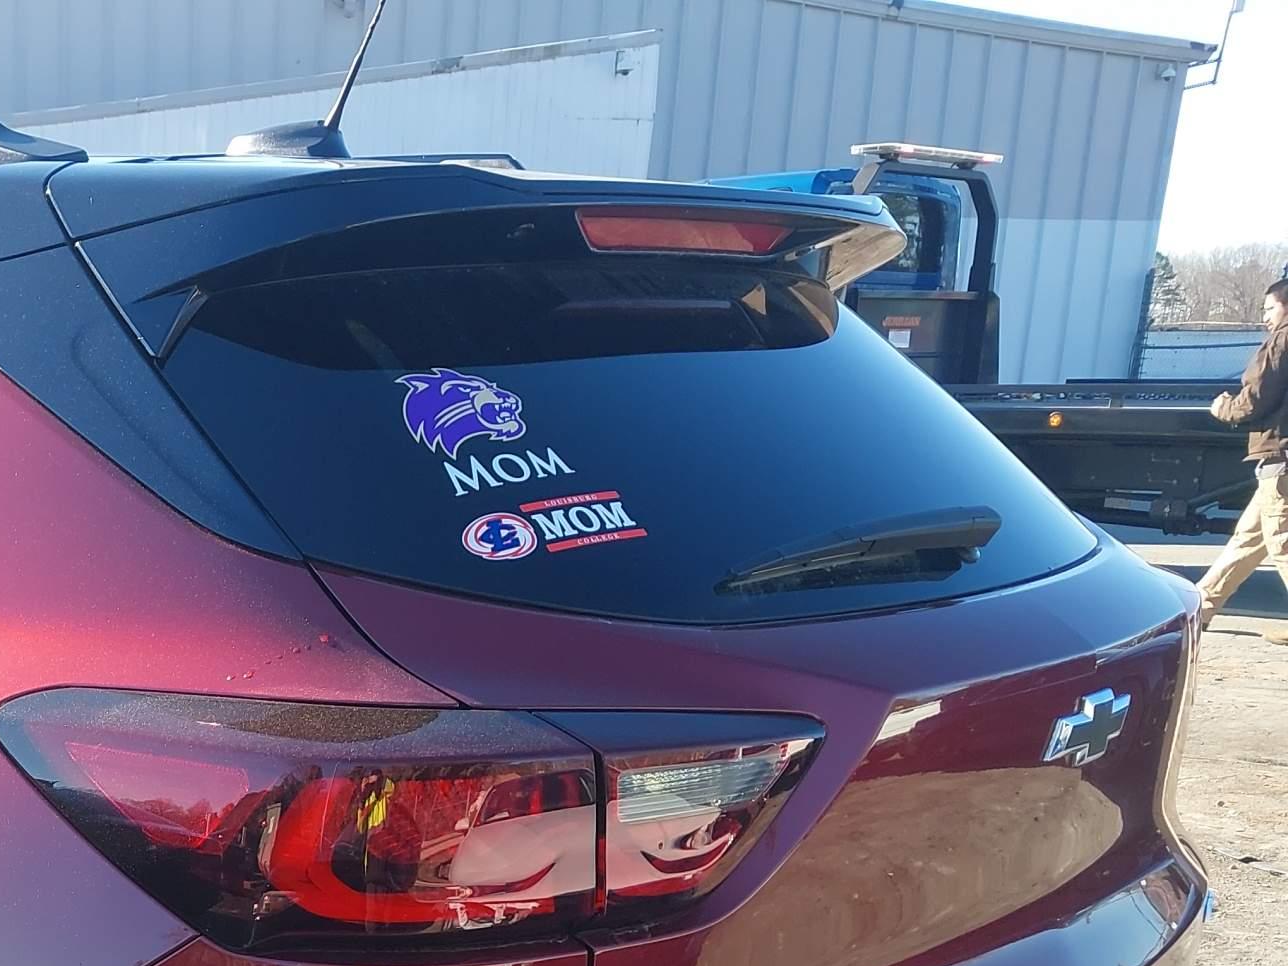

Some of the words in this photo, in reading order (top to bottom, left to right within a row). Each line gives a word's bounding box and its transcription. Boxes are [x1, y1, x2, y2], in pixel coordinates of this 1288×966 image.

[443, 446, 576, 497] MOM
[531, 501, 637, 540] MOM
[577, 532, 620, 545] COLLEGE
